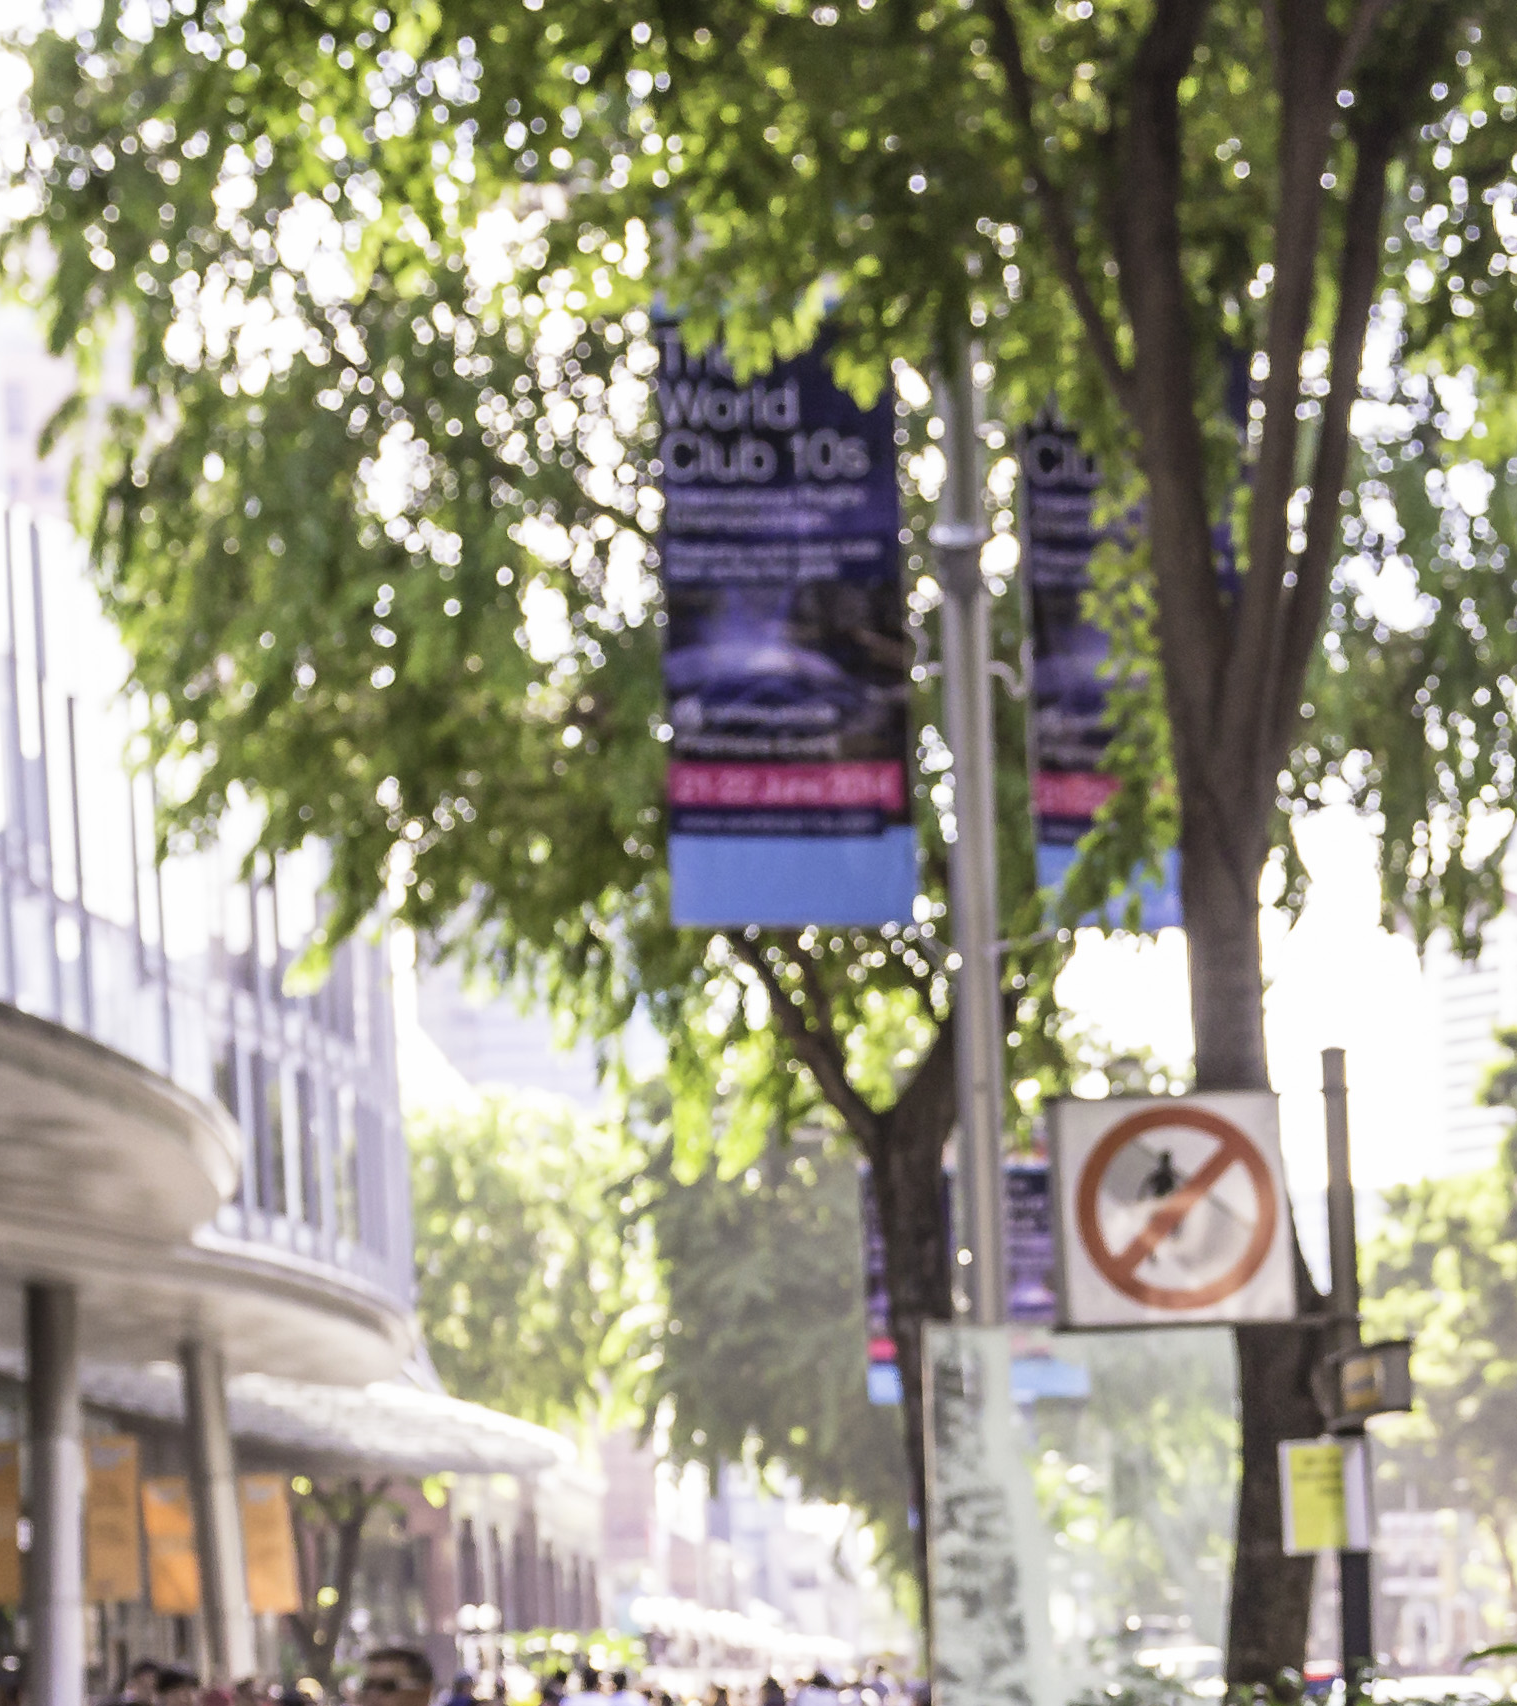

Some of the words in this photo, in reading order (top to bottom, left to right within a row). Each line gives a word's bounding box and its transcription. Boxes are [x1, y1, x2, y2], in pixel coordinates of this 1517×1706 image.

[659, 378, 801, 432] World
[660, 428, 778, 484] Club
[791, 427, 871, 481] 10s
